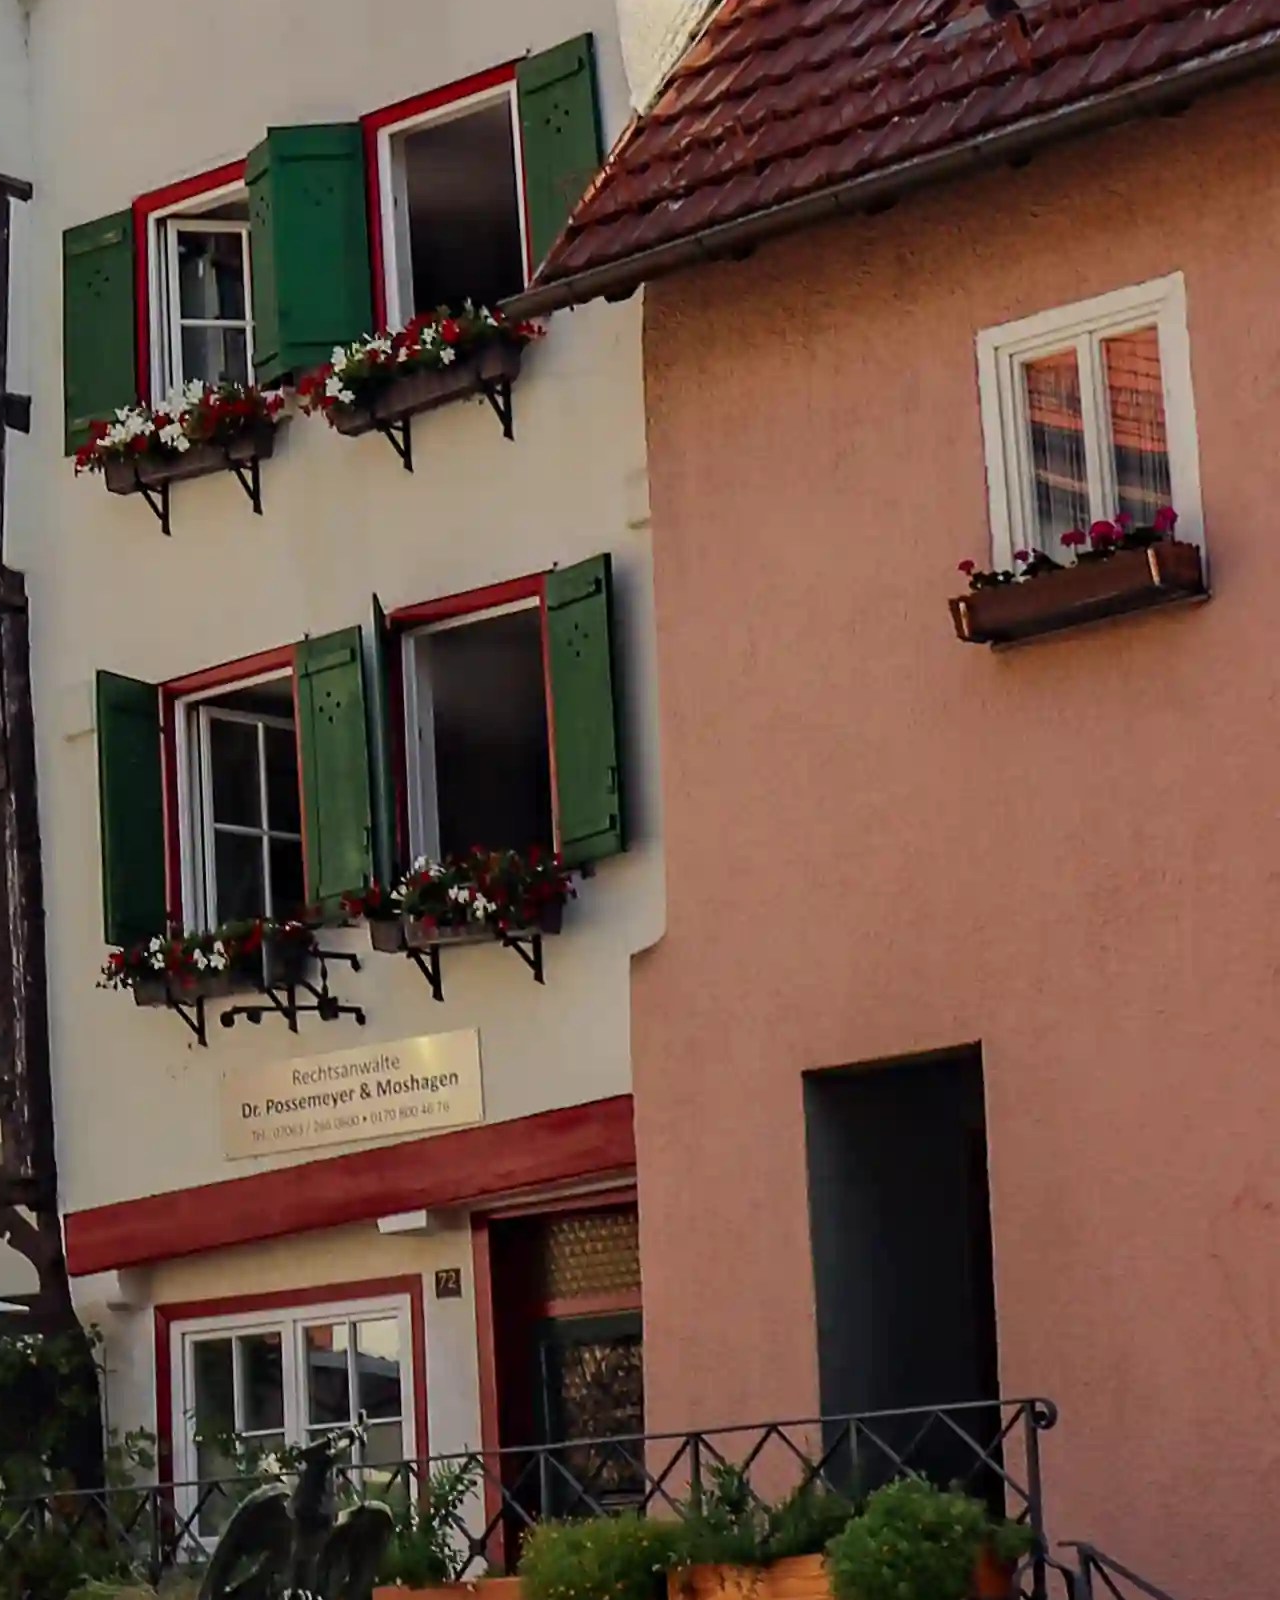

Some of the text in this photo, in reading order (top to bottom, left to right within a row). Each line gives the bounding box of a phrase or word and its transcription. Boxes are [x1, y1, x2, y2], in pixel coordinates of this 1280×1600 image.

[292, 1054, 400, 1086] Rechtsanwälte
[242, 1071, 459, 1119] Dr. Possemeyer & Moshagen
[438, 1271, 456, 1288] 72
